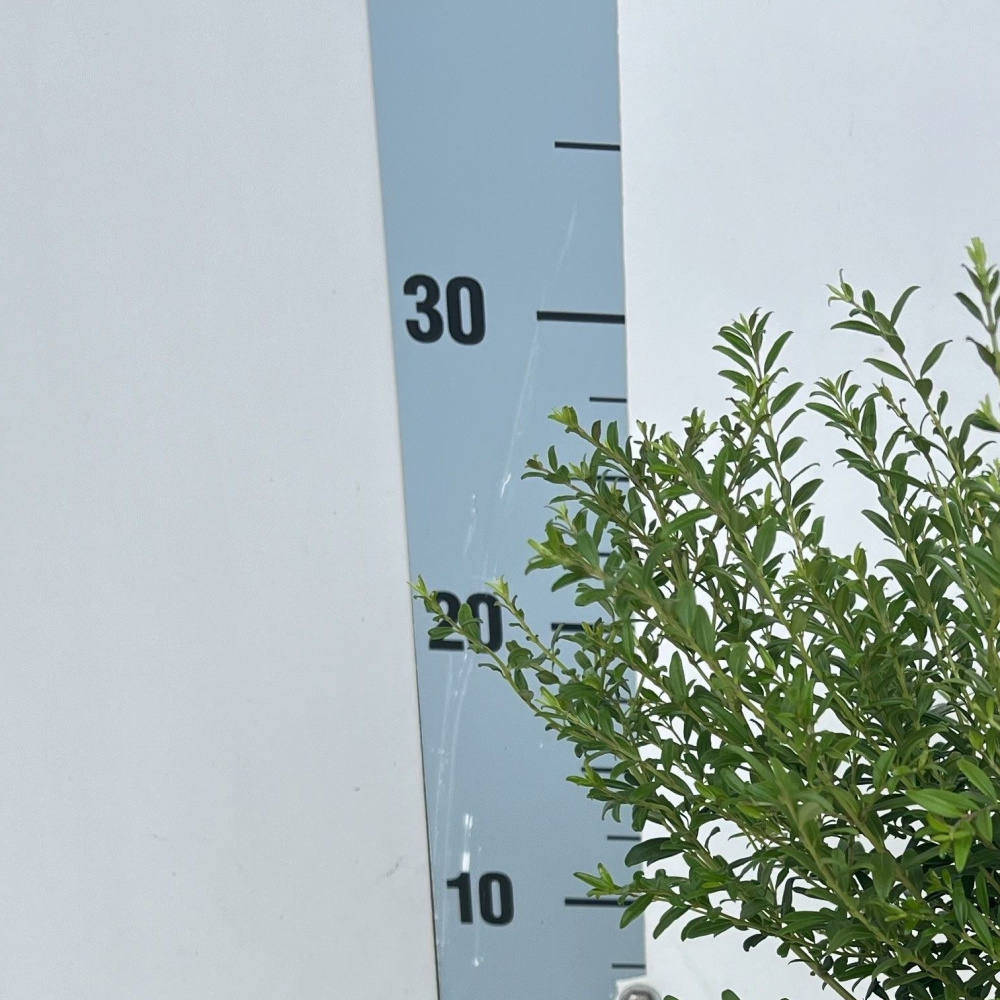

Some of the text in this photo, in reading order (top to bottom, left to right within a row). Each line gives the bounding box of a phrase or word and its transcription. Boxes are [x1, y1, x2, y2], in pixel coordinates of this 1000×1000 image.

[403, 274, 486, 345] 30
[428, 590, 503, 652] 20
[446, 870, 514, 927] 10
